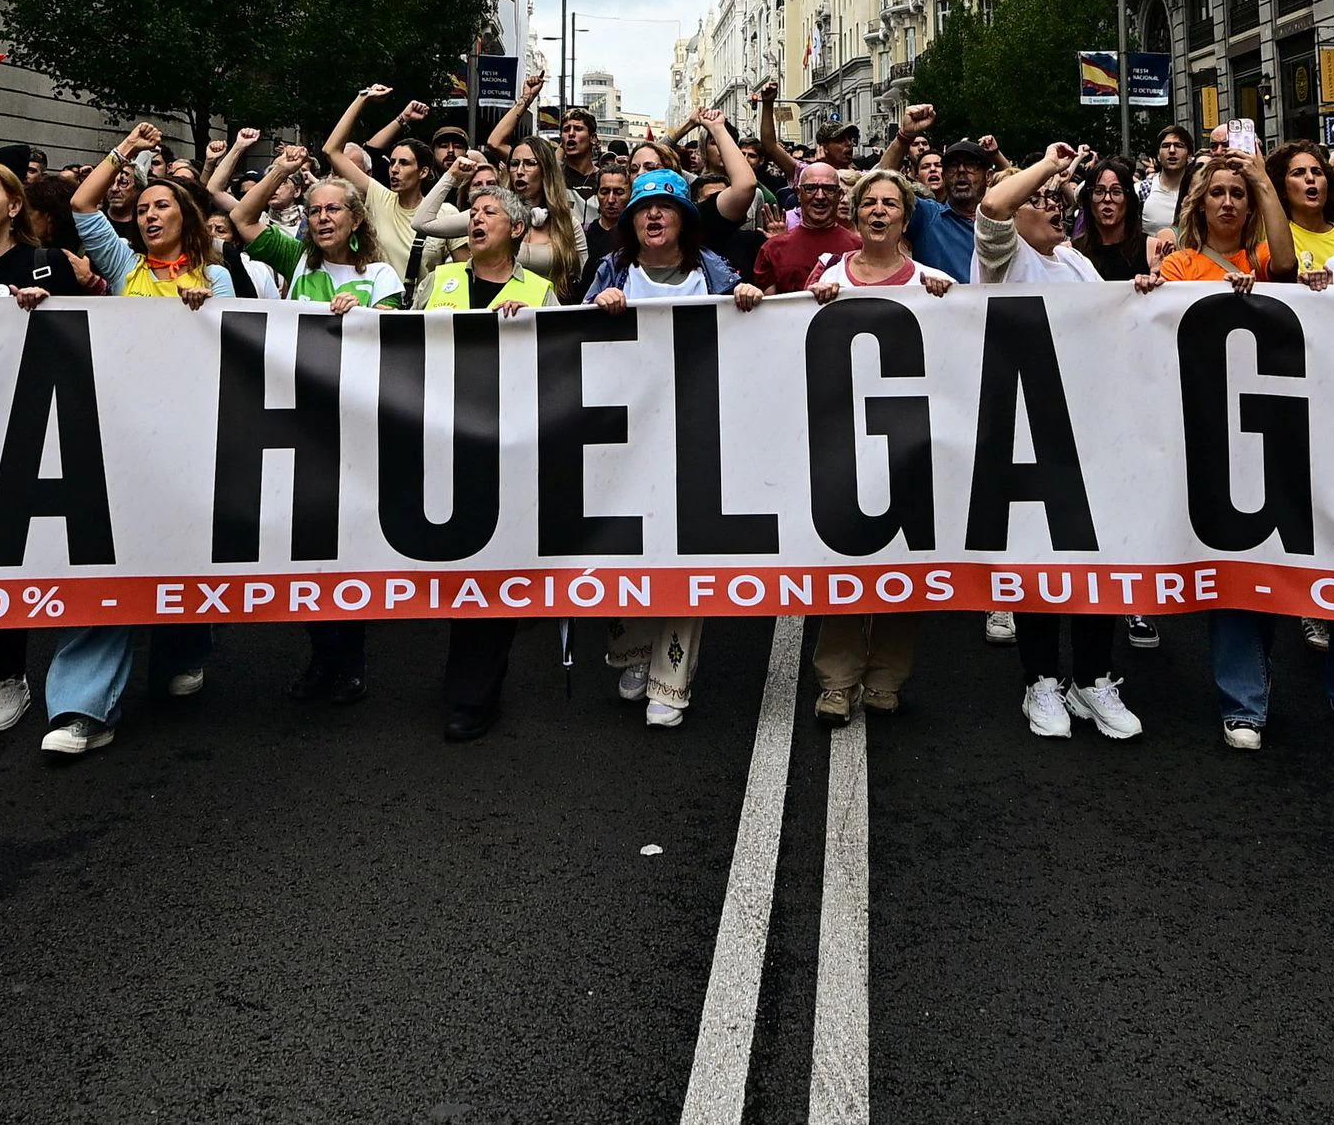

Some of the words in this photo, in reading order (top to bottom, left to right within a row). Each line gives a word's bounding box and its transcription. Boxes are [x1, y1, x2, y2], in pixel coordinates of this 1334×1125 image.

[210, 295, 1101, 564] HUELGA
[154, 567, 652, 615] EXPROPIACIÓN
[688, 568, 955, 607] FONDOS
[990, 567, 1220, 606] BUITRE
